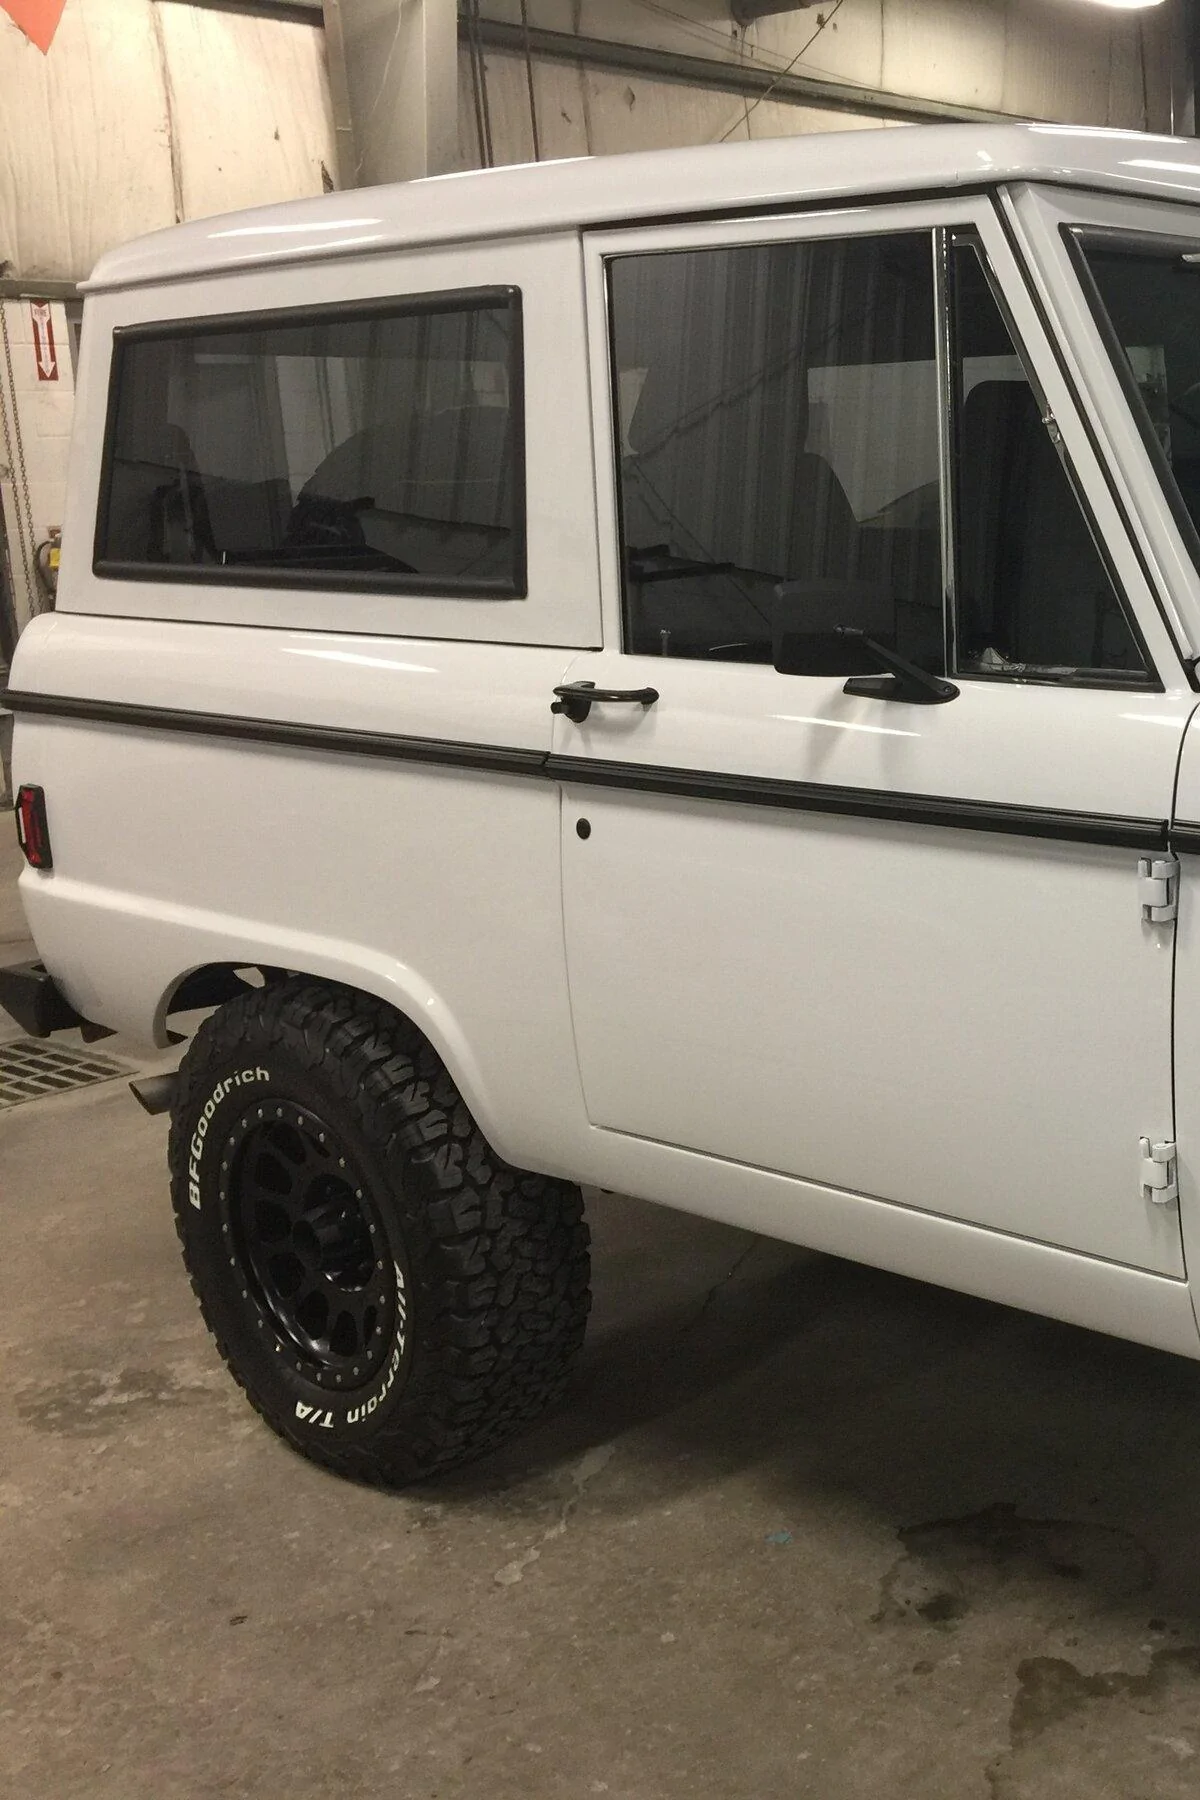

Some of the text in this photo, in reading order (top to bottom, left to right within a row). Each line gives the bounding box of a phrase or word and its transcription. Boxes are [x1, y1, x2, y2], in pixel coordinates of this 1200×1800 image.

[188, 1066, 270, 1210] BFGoodrich
[295, 1259, 407, 1429] All-Terrain T/A
